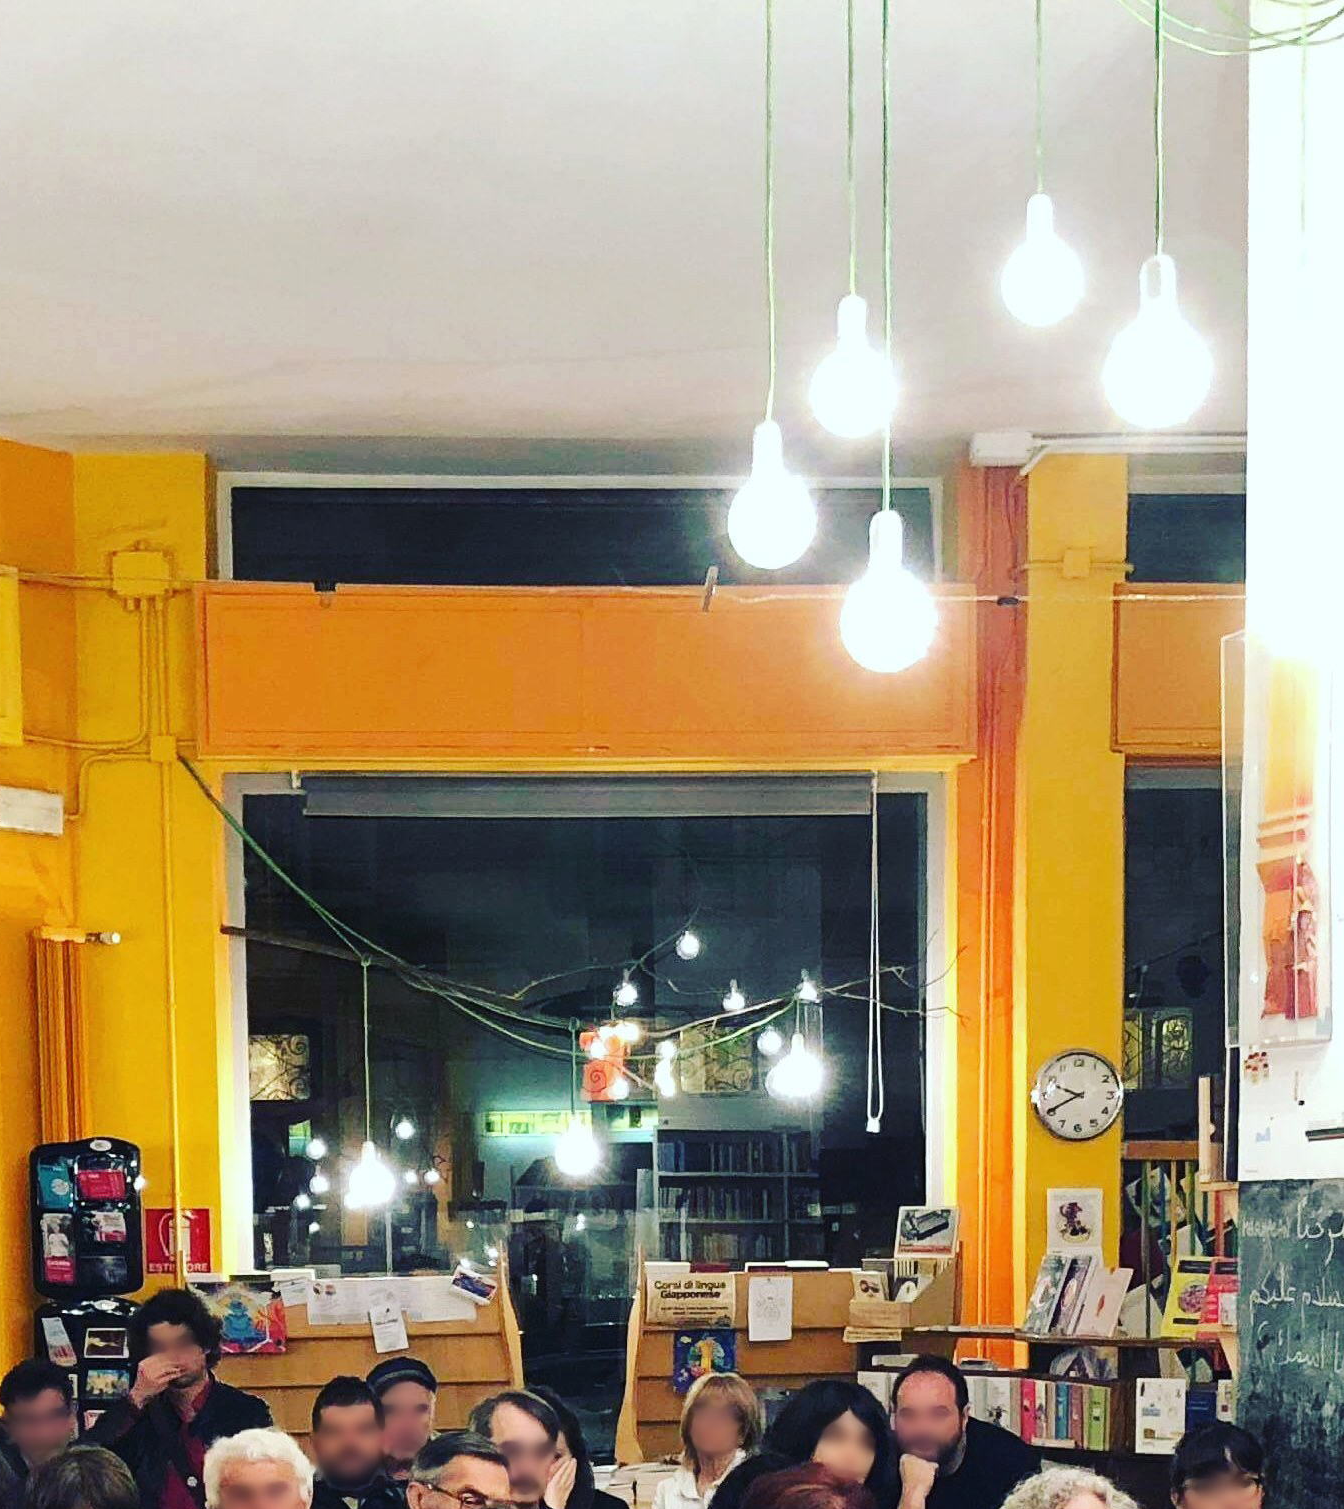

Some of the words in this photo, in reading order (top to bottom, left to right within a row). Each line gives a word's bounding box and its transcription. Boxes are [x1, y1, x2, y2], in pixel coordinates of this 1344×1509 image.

[148, 1262, 208, 1273] ESTIORE
[654, 1280, 681, 1290] Corsi
[684, 1280, 693, 1290] di
[695, 1280, 726, 1291] lingua
[660, 1290, 721, 1300] Giapponese
